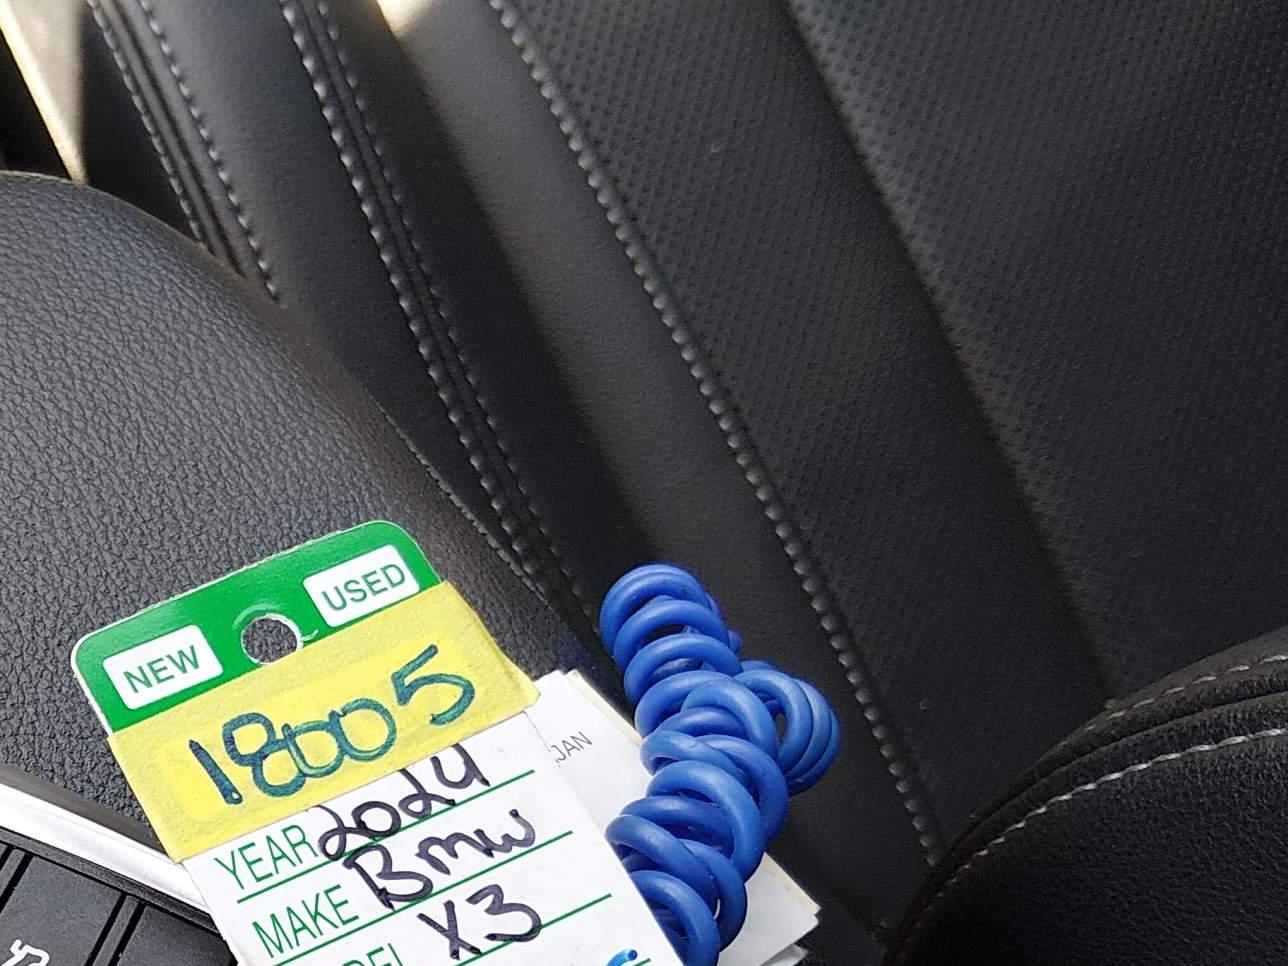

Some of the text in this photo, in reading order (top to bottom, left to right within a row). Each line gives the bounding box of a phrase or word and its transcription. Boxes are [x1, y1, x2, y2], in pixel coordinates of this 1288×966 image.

[321, 563, 406, 612] USED
[124, 644, 201, 694] NEW
[188, 644, 476, 806] 18005
[549, 731, 593, 764] JAN
[317, 743, 491, 862] 2024
[213, 824, 318, 890] YEAR
[251, 884, 360, 959] MAKE
